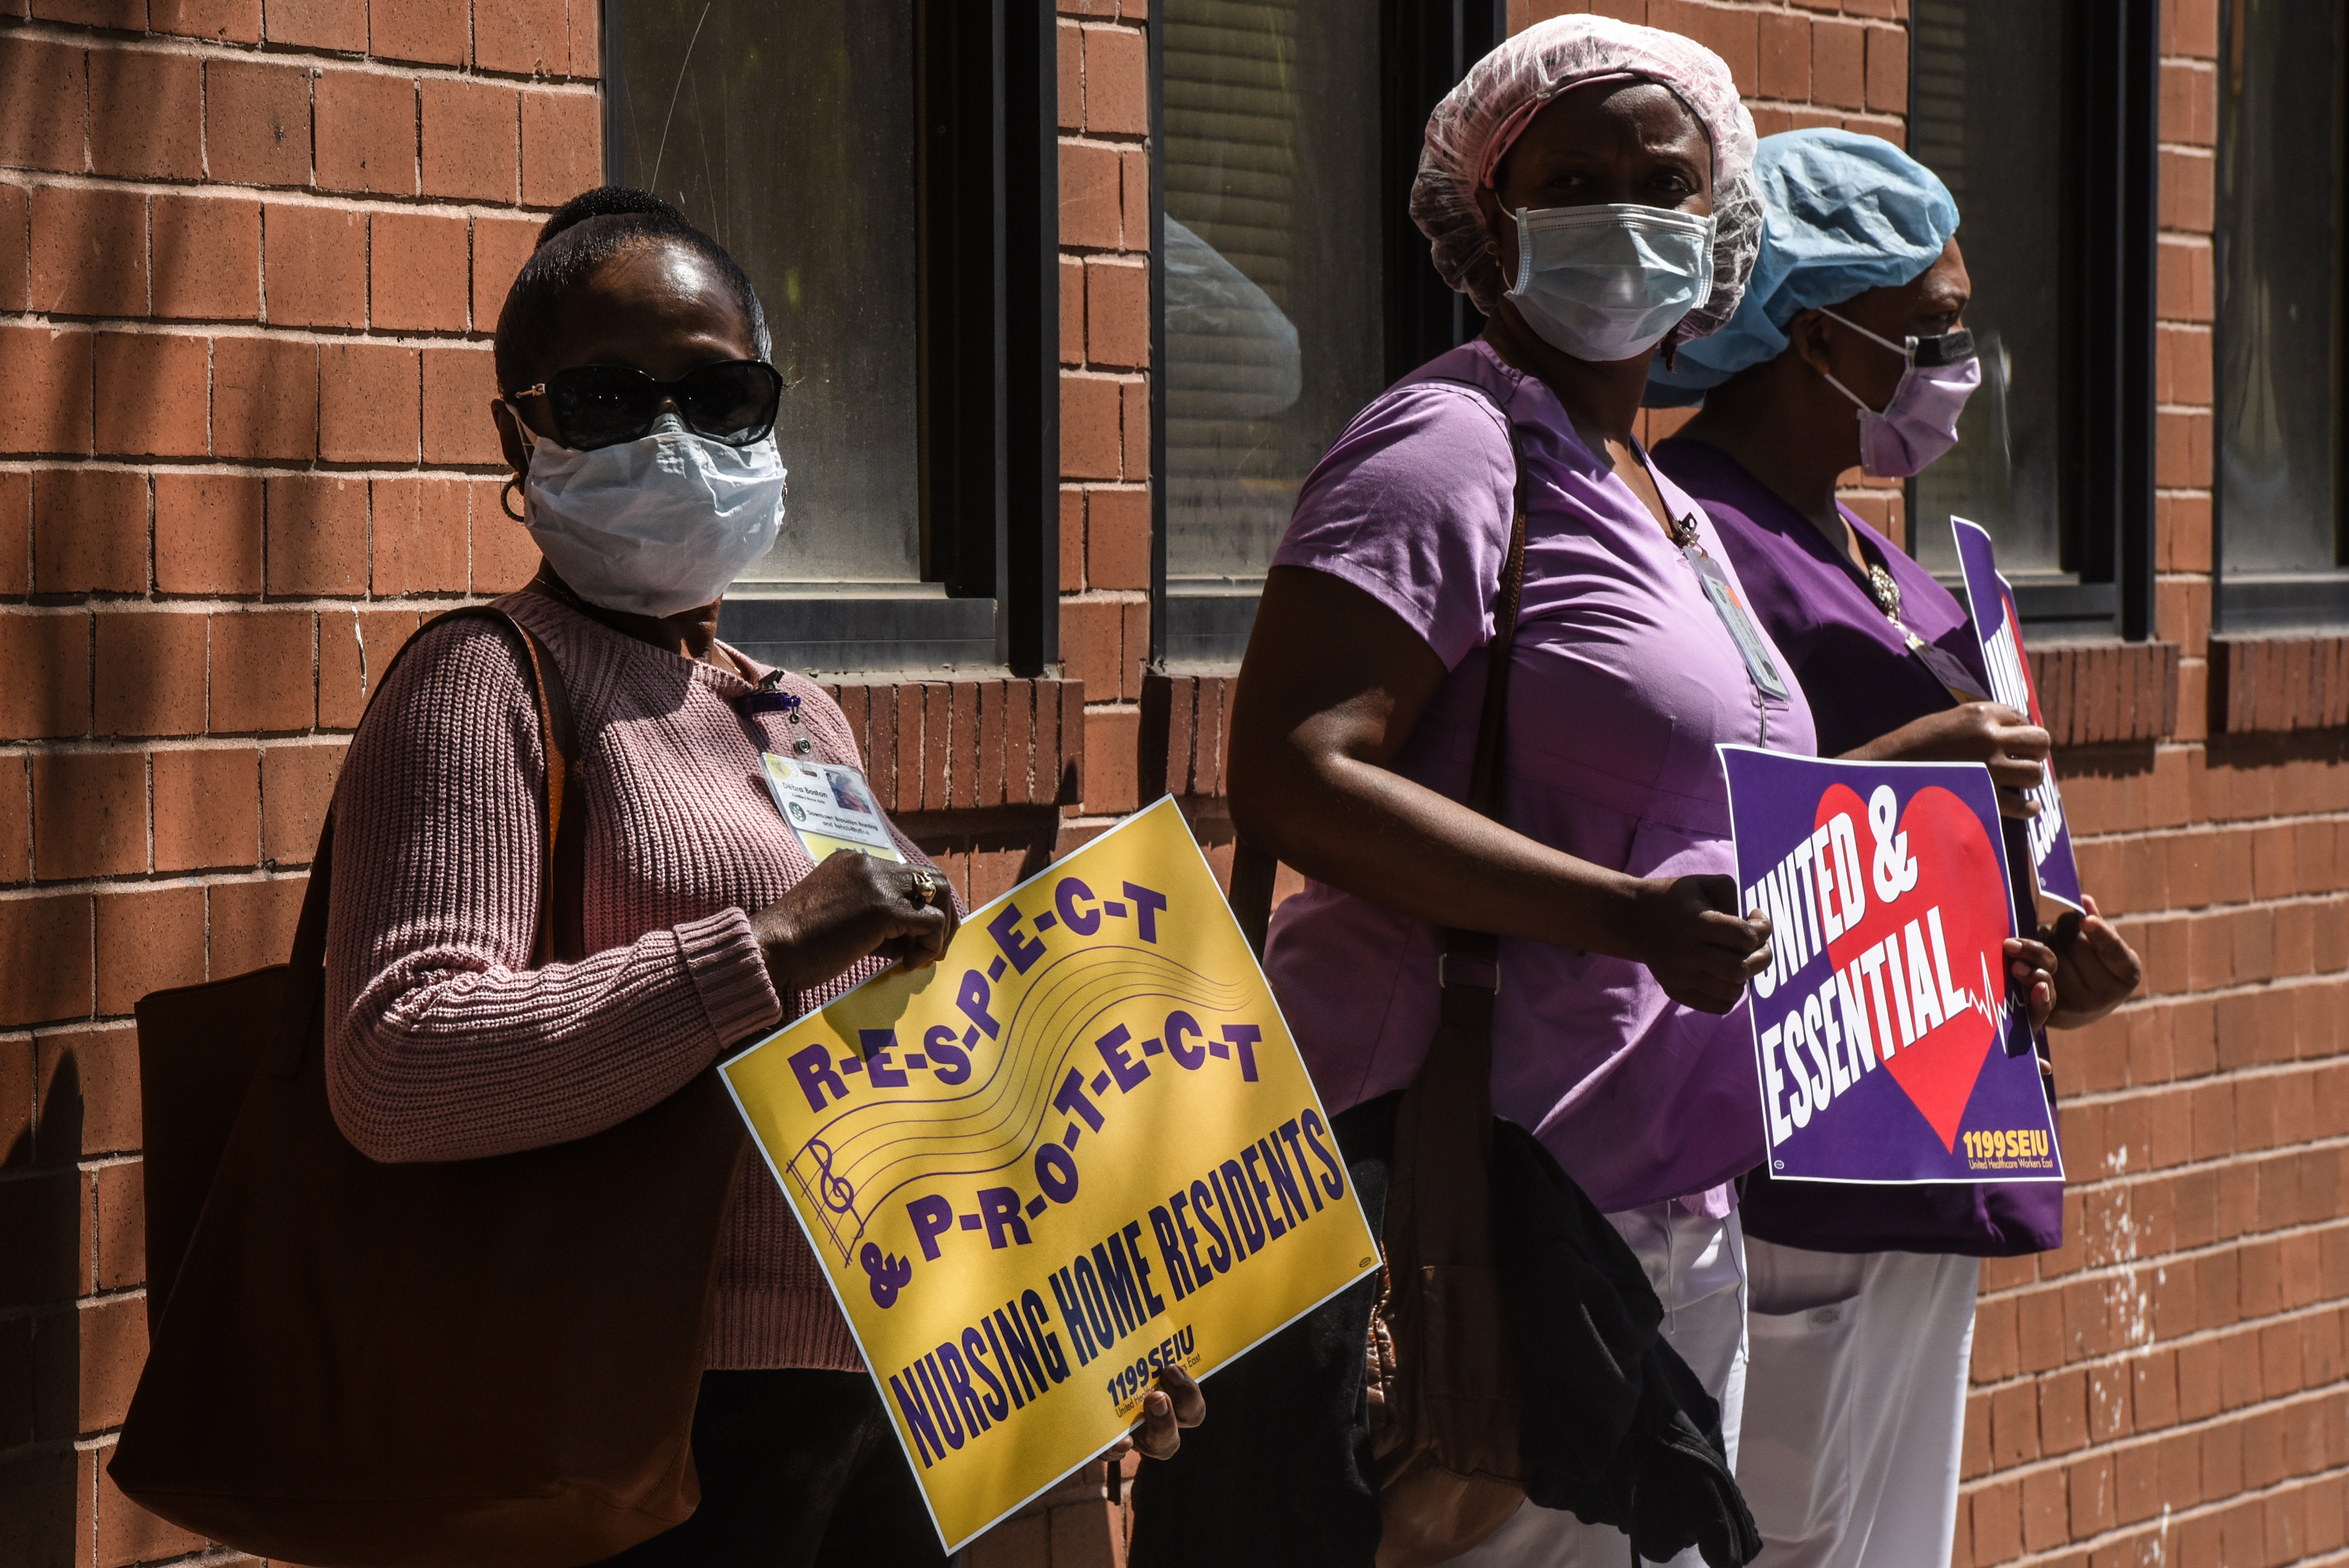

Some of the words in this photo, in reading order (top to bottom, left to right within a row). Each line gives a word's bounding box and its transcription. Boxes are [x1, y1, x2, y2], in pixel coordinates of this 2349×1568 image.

[782, 782, 804, 793] Debra
[805, 787, 828, 799] Boston
[807, 810, 835, 821] Downtown
[835, 816, 858, 827] Brooklyn
[857, 821, 879, 831] Nursing
[1745, 812, 1865, 998] UNITED
[1868, 785, 1918, 903] &
[788, 877, 1167, 1113] R-E-S-P-E-C-T
[1761, 905, 1967, 1147] ESSENTIAL
[860, 1242, 912, 1309] &
[907, 1010, 1262, 1262] P-R-O-T-E-C-T
[1963, 1130, 2049, 1158] 1199SEIU
[1968, 1158, 1988, 1170] United
[1988, 1157, 2018, 1169] Healthcare
[2018, 1158, 2041, 1169] Workers
[2041, 1158, 2053, 1169] East
[889, 1290, 1071, 1469] NURSING
[1049, 1221, 1166, 1367] HOME
[1148, 1108, 1344, 1302] RESIDENTS
[1107, 1324, 1194, 1407] 1199SEIU
[1115, 1397, 1135, 1418] United
[1187, 1353, 1202, 1368] East
